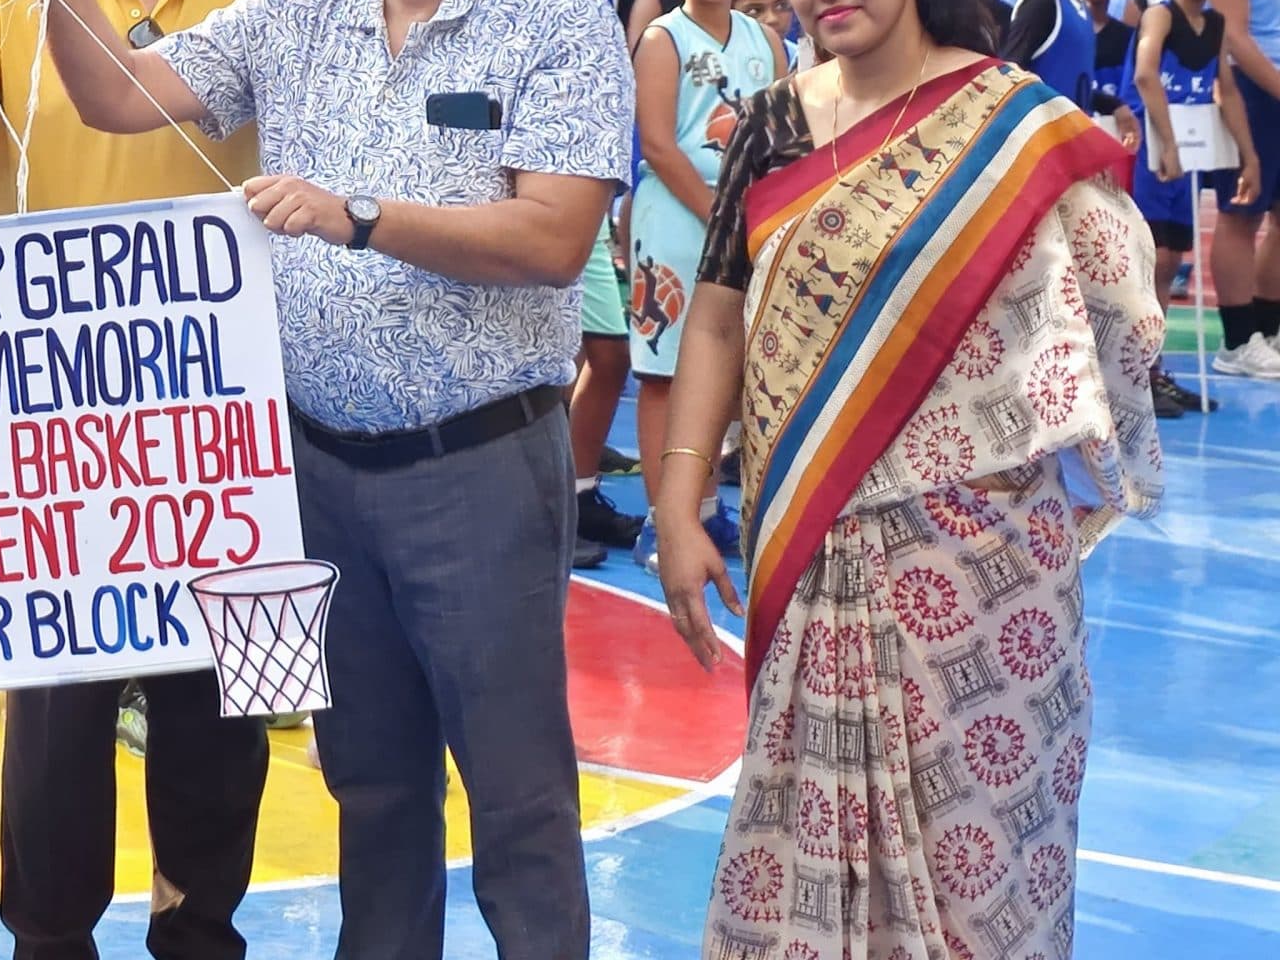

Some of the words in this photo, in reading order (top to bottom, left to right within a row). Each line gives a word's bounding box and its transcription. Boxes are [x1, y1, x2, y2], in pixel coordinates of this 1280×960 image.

[14, 215, 242, 321] GERALD
[12, 398, 292, 500] BASKETBALL
[108, 486, 261, 575] 2025
[25, 580, 190, 659] BLOCK
